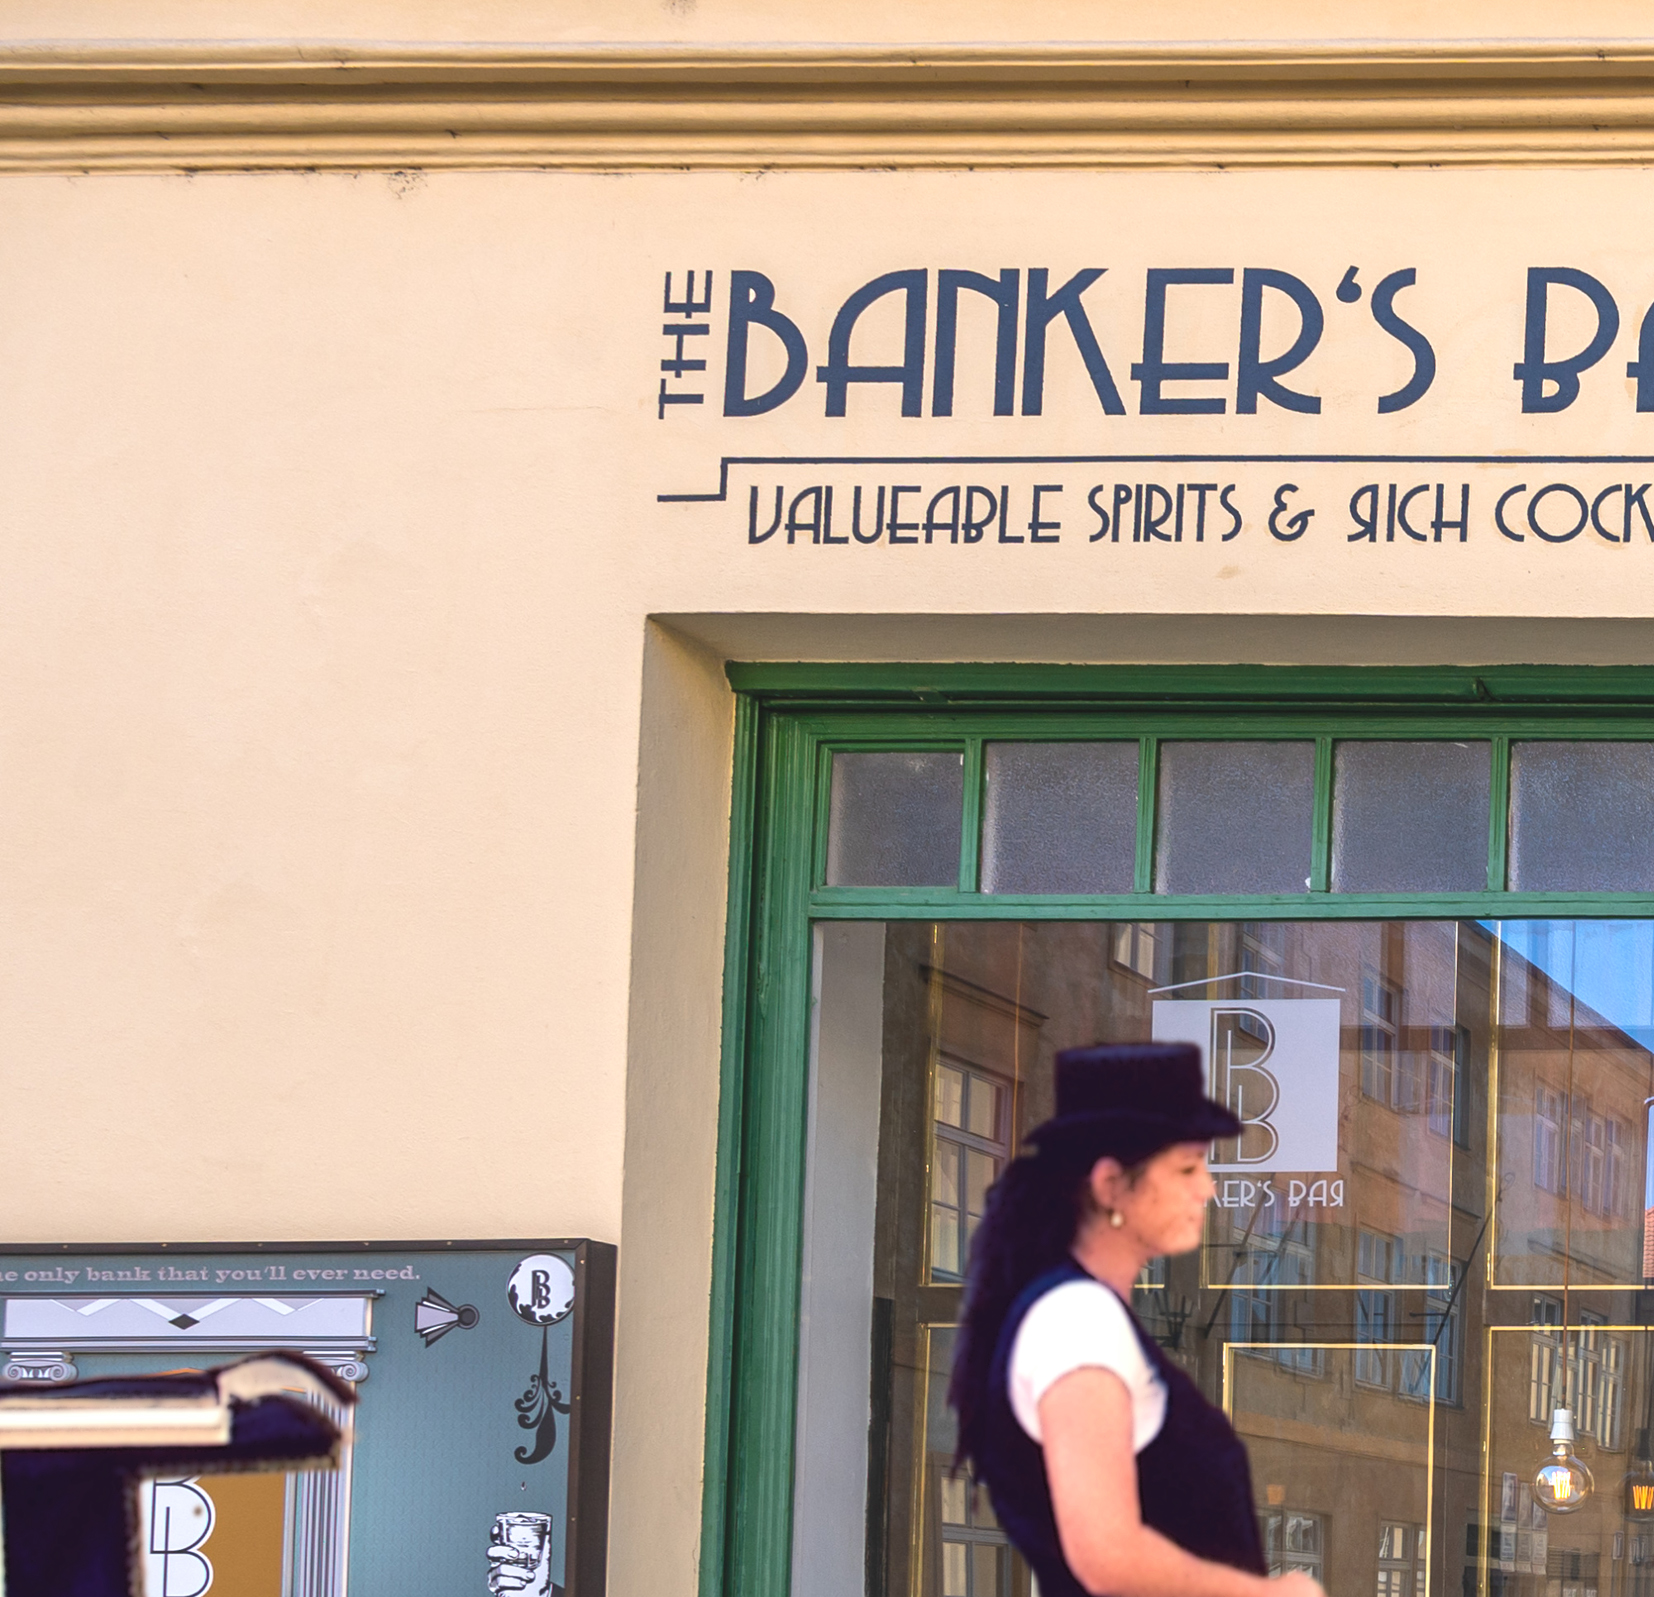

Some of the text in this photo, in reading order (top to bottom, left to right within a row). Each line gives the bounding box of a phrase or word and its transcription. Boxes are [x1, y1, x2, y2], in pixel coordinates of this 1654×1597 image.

[658, 269, 713, 420] THE
[722, 265, 1437, 419] BANKER'S
[747, 484, 1064, 545] VALUEABLE
[1087, 483, 1243, 543] SPIRITS
[1267, 483, 1316, 542] &
[23, 1266, 80, 1285] only
[86, 1266, 153, 1283] bank
[157, 1265, 210, 1283] that
[215, 1265, 287, 1284] you'll
[292, 1266, 348, 1283] ever
[353, 1264, 421, 1282] need.
